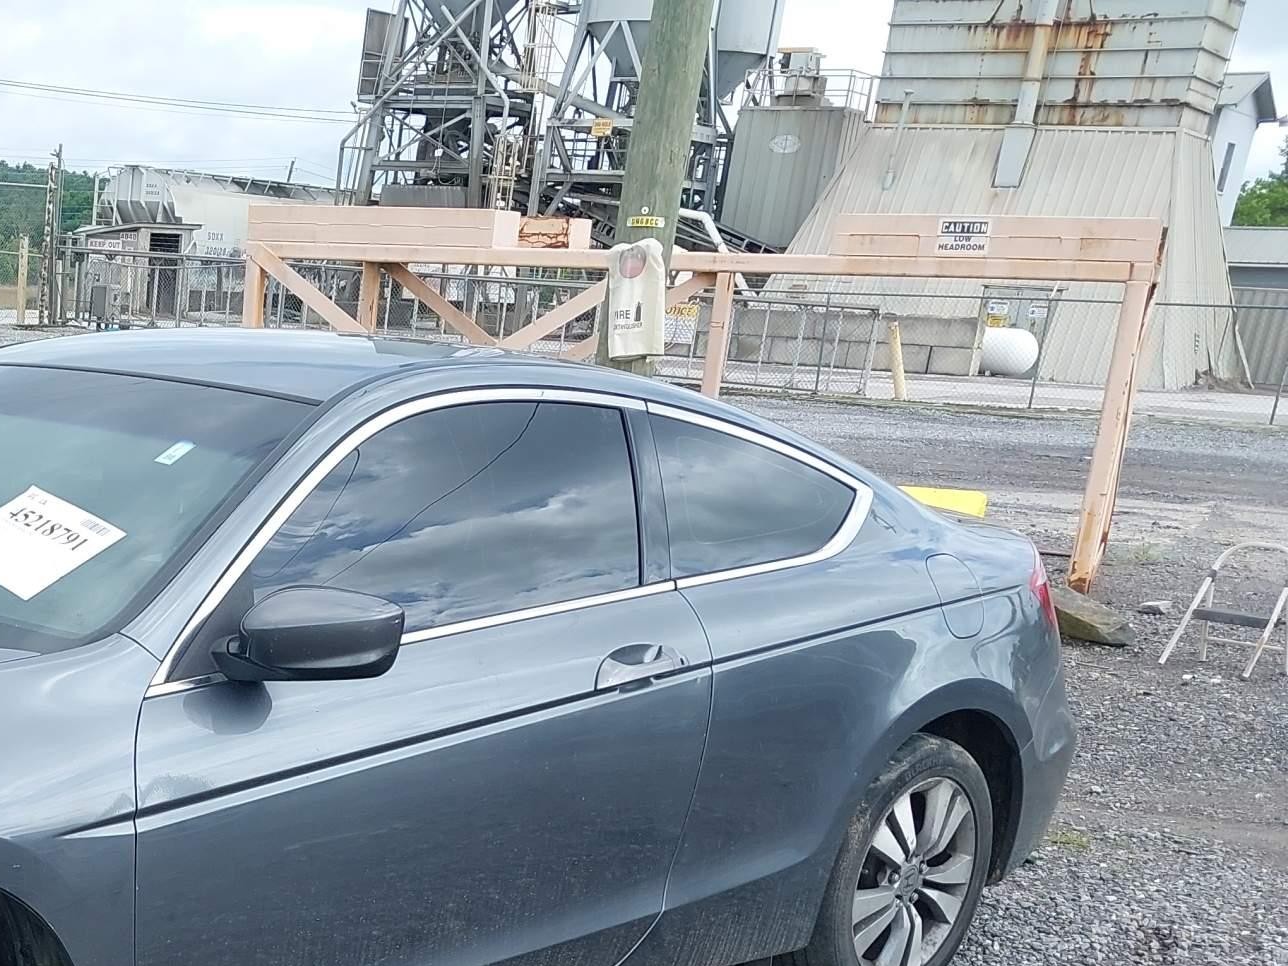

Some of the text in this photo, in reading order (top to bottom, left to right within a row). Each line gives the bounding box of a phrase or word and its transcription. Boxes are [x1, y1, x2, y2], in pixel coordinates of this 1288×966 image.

[942, 222, 988, 233] CAUTION
[938, 243, 985, 251] HEADROOM
[9, 507, 89, 551] 45218791
